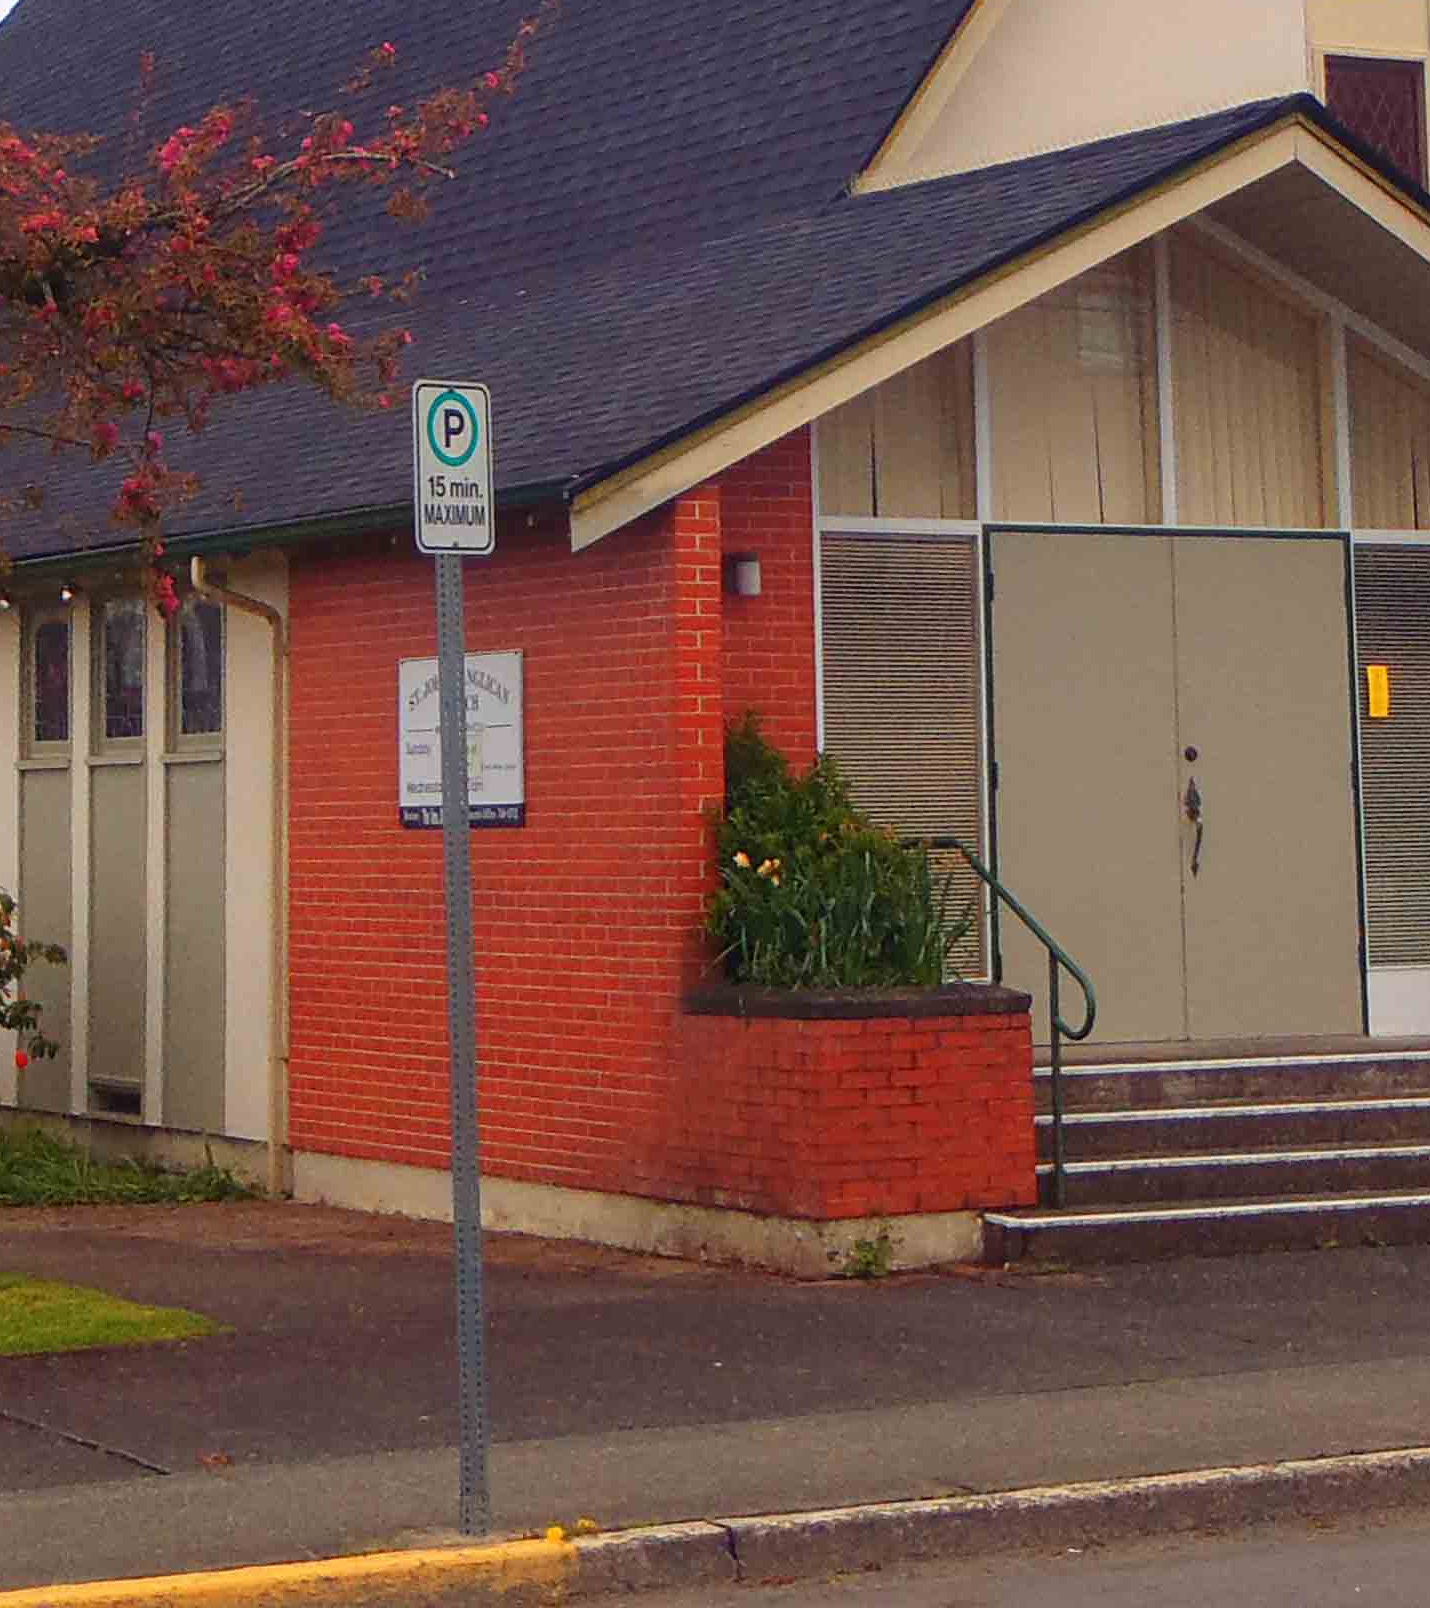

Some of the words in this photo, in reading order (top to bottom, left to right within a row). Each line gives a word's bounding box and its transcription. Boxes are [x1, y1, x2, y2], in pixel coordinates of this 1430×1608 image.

[443, 408, 465, 448] P
[428, 476, 446, 498] 15
[449, 477, 484, 499] min.
[424, 503, 486, 526] MAXIMUM
